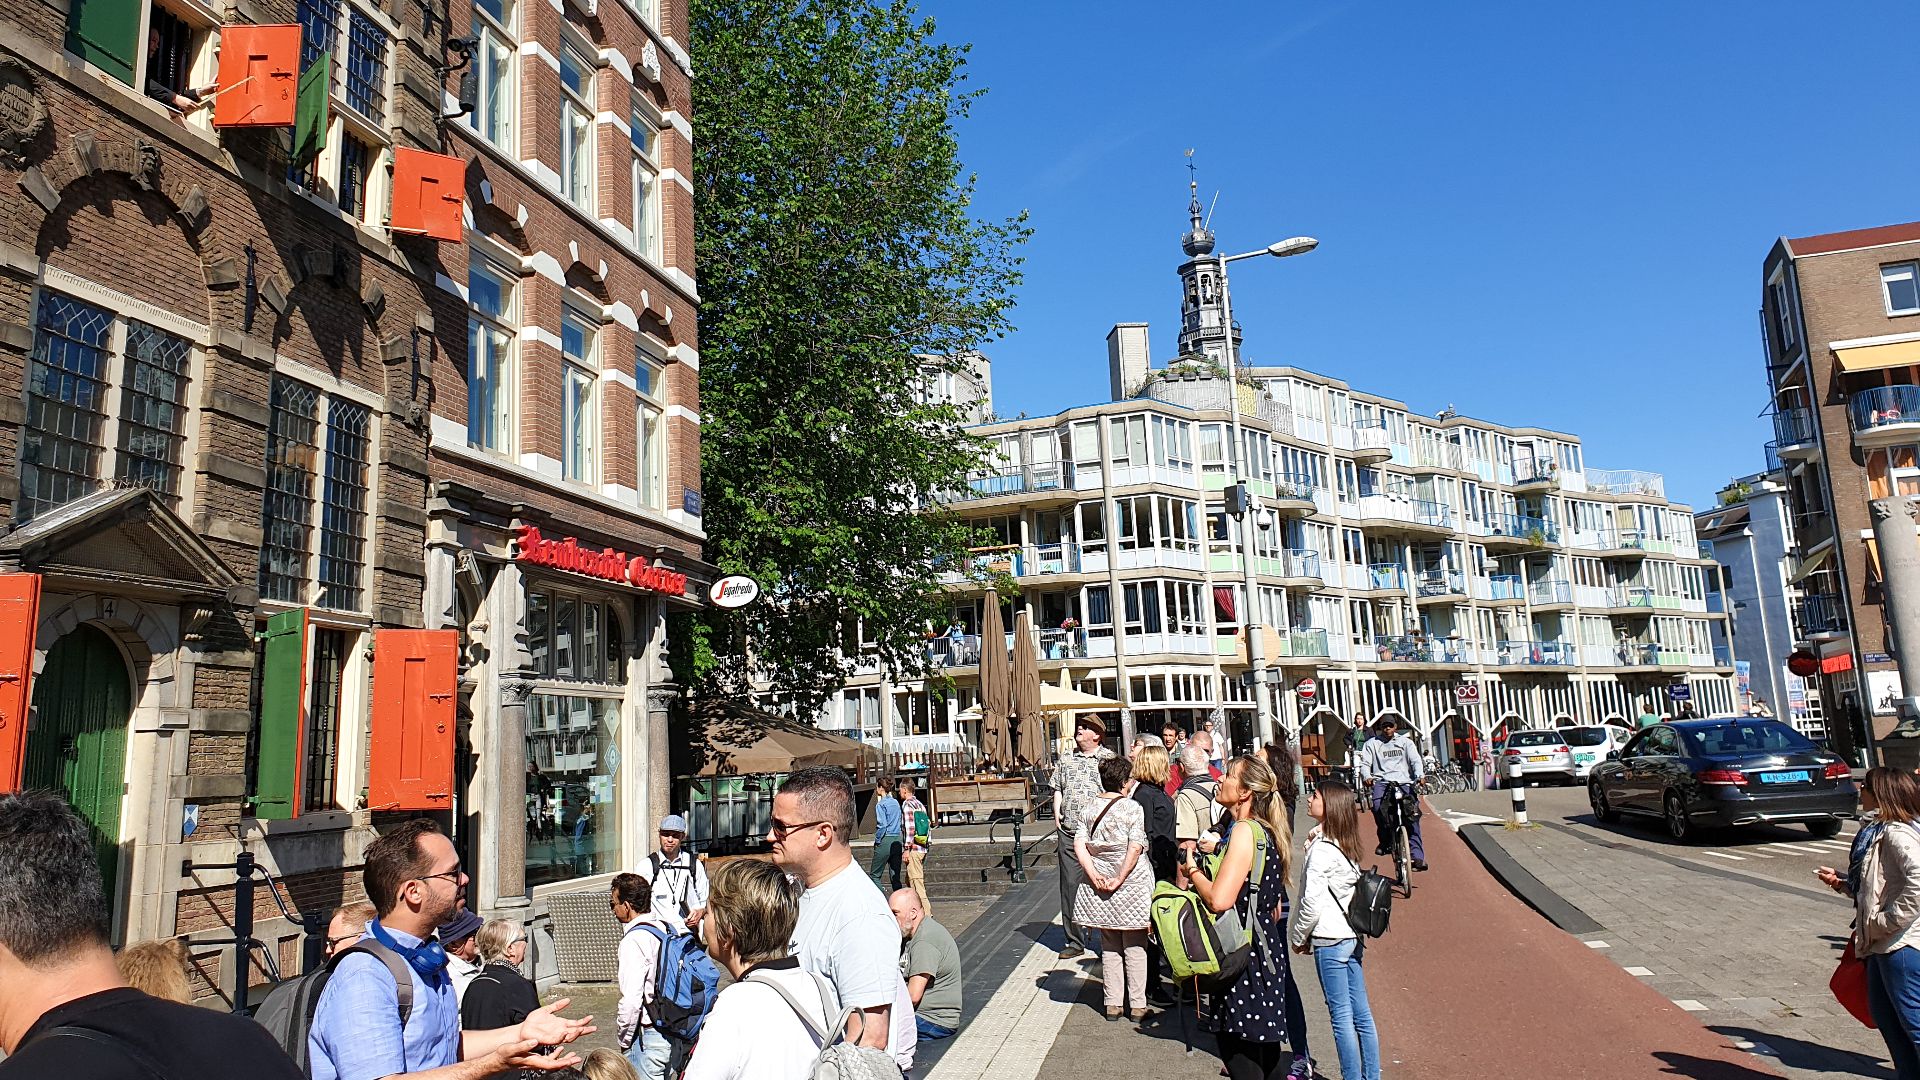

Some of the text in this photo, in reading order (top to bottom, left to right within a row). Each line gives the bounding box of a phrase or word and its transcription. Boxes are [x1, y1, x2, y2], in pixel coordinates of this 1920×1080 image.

[516, 524, 688, 596] Rembrandt Corner
[715, 581, 753, 600] Segafredo
[104, 600, 114, 618] 4
[1382, 750, 1403, 758] PUMA
